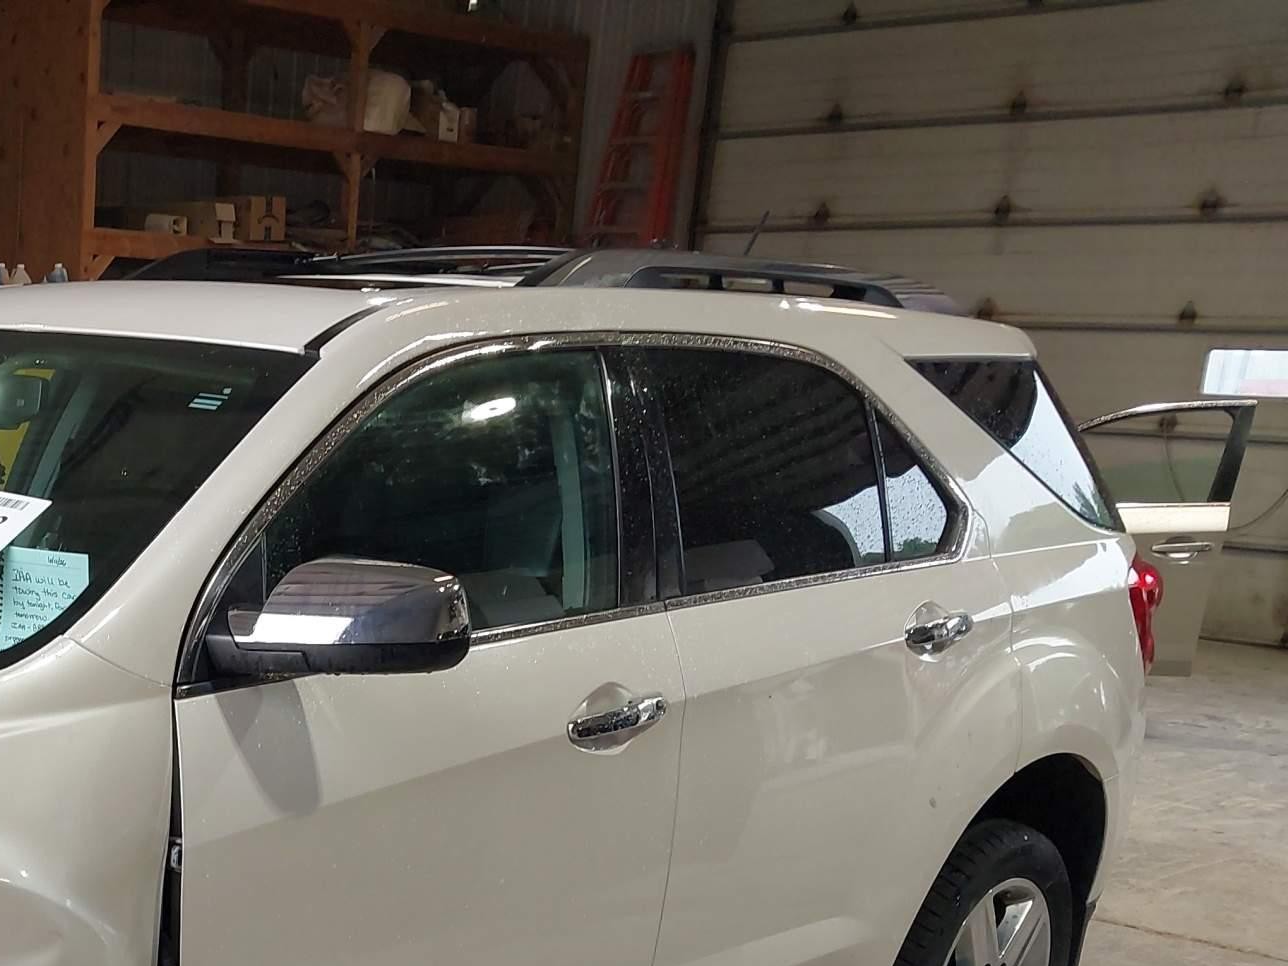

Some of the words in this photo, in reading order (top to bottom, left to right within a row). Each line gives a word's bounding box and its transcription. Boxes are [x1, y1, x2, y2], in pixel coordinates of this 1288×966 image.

[12, 568, 32, 583] IAA
[35, 576, 54, 585] will
[58, 578, 70, 588] be
[42, 588, 58, 598] this
[13, 597, 25, 610] by
